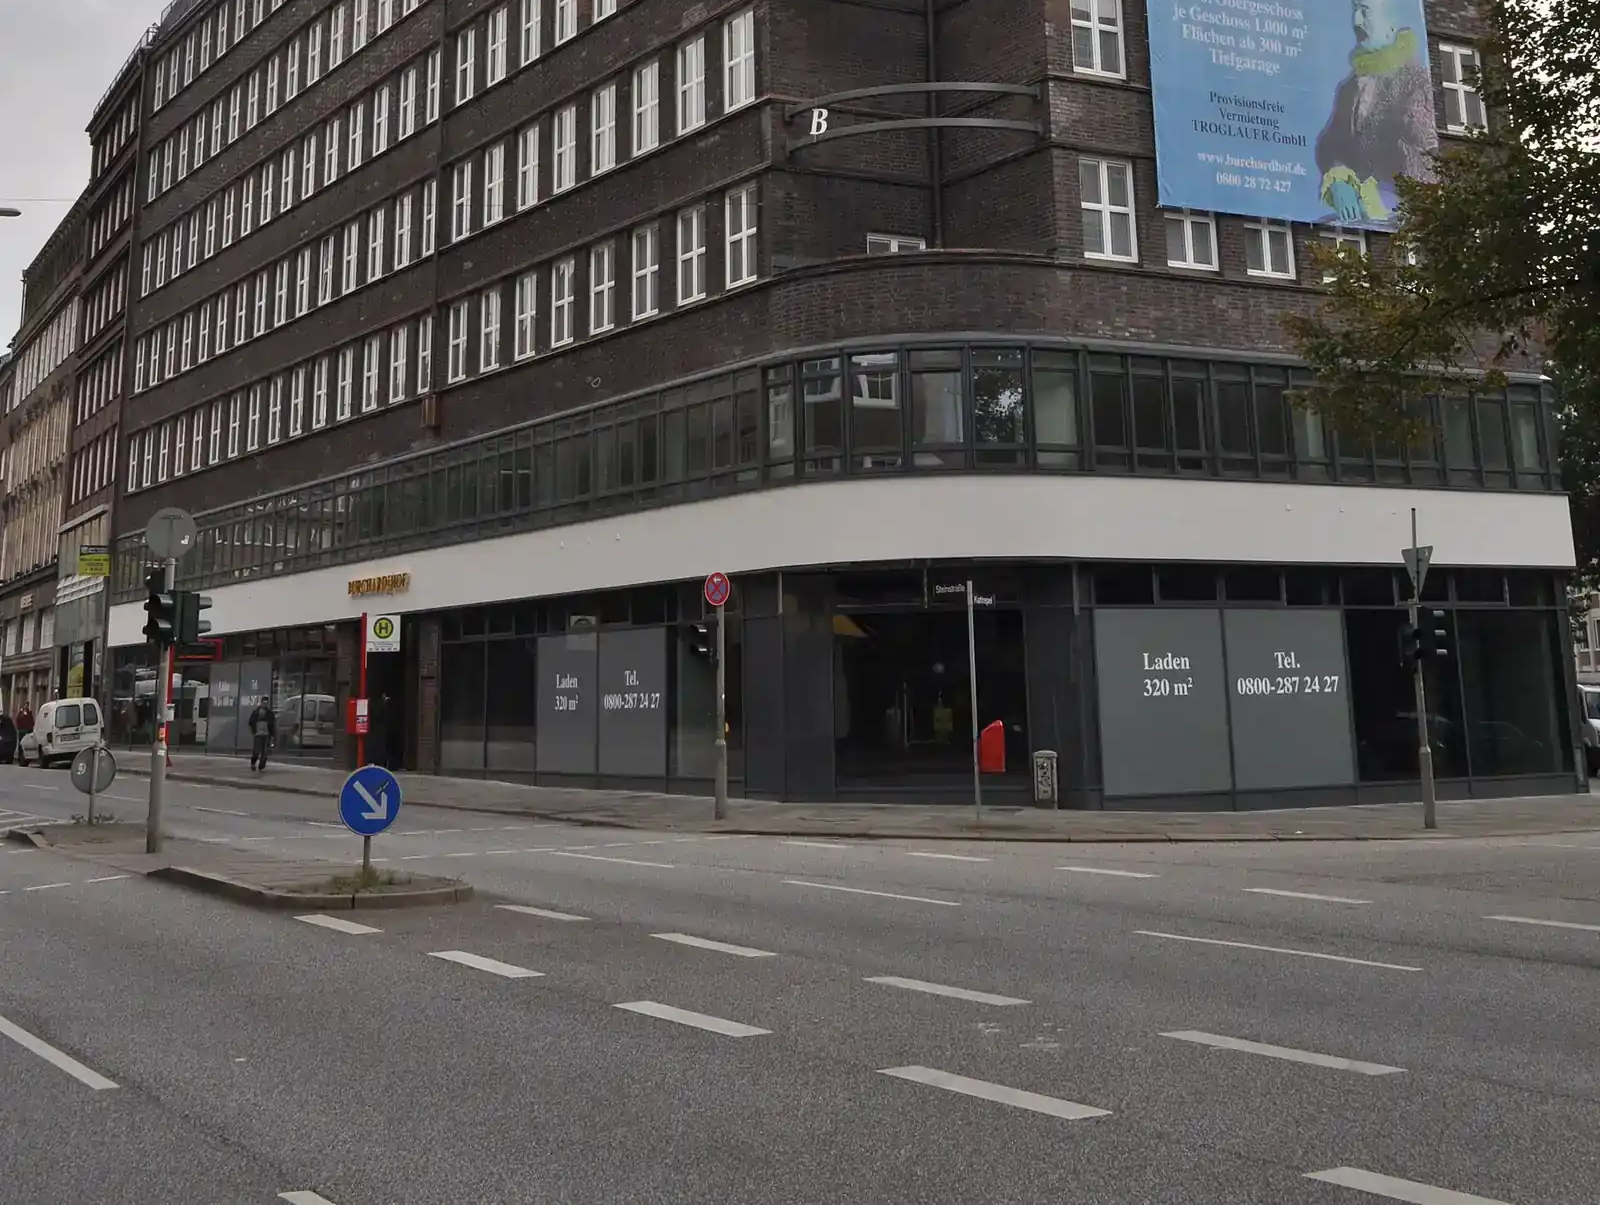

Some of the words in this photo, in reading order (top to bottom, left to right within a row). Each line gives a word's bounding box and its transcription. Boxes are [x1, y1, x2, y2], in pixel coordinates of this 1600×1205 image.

[1172, 1, 1187, 21] je
[1189, 5, 1251, 30] Geschoss
[1255, 17, 1288, 37] 1.000
[1182, 23, 1236, 48] Flächen
[1239, 35, 1256, 50] ab
[1259, 37, 1283, 54] 300
[1208, 47, 1281, 77] Tiefgarage
[1209, 91, 1285, 114] Provisionsfreie
[809, 108, 829, 136] B
[1219, 107, 1280, 130] Vermietung
[1191, 119, 1270, 142] TROGLAUER
[1272, 131, 1308, 147] GmbH
[1197, 152, 1308, 176] www.burchardhof.de
[1216, 171, 1241, 188] 0800
[1243, 175, 1257, 189] 28
[1273, 179, 1293, 193] 427
[1143, 653, 1191, 671] Laden
[1274, 651, 1301, 669] Tel.
[556, 673, 578, 689] Laden
[624, 669, 640, 686] Tel.
[1143, 678, 1170, 697] 320
[1173, 677, 1193, 696] m²
[1237, 677, 1300, 695] 0800-287
[1303, 677, 1320, 693] 24
[1323, 676, 1339, 693] 27
[555, 695, 568, 711] 320
[568, 694, 579, 711] m²
[603, 693, 638, 710] 0800-287
[639, 693, 649, 709] 24
[650, 692, 660, 709] 27
